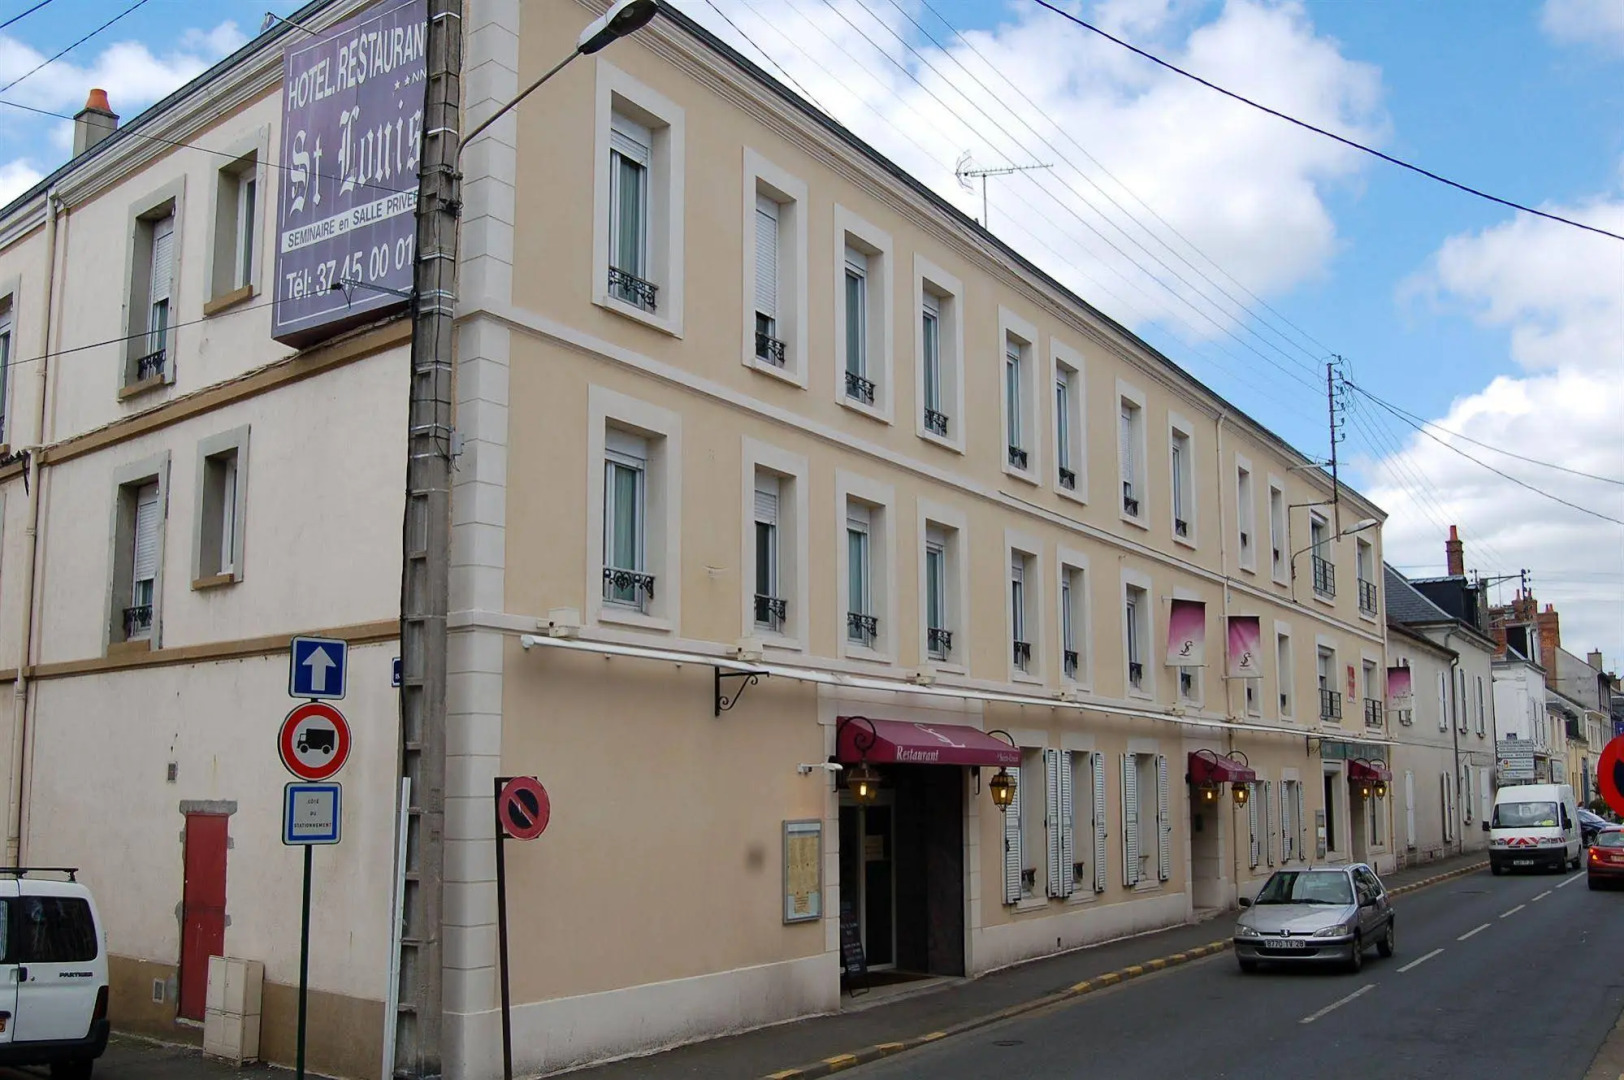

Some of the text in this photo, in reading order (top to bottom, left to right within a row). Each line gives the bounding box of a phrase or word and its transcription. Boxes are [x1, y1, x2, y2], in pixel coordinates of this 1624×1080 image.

[289, 99, 422, 216] St Louis
[288, 219, 335, 248] SEMINAIRE
[339, 217, 349, 230] en
[353, 202, 383, 226] SALLE
[286, 234, 413, 300] Tél: 37 45 00 01
[896, 745, 939, 762] Restaurant
